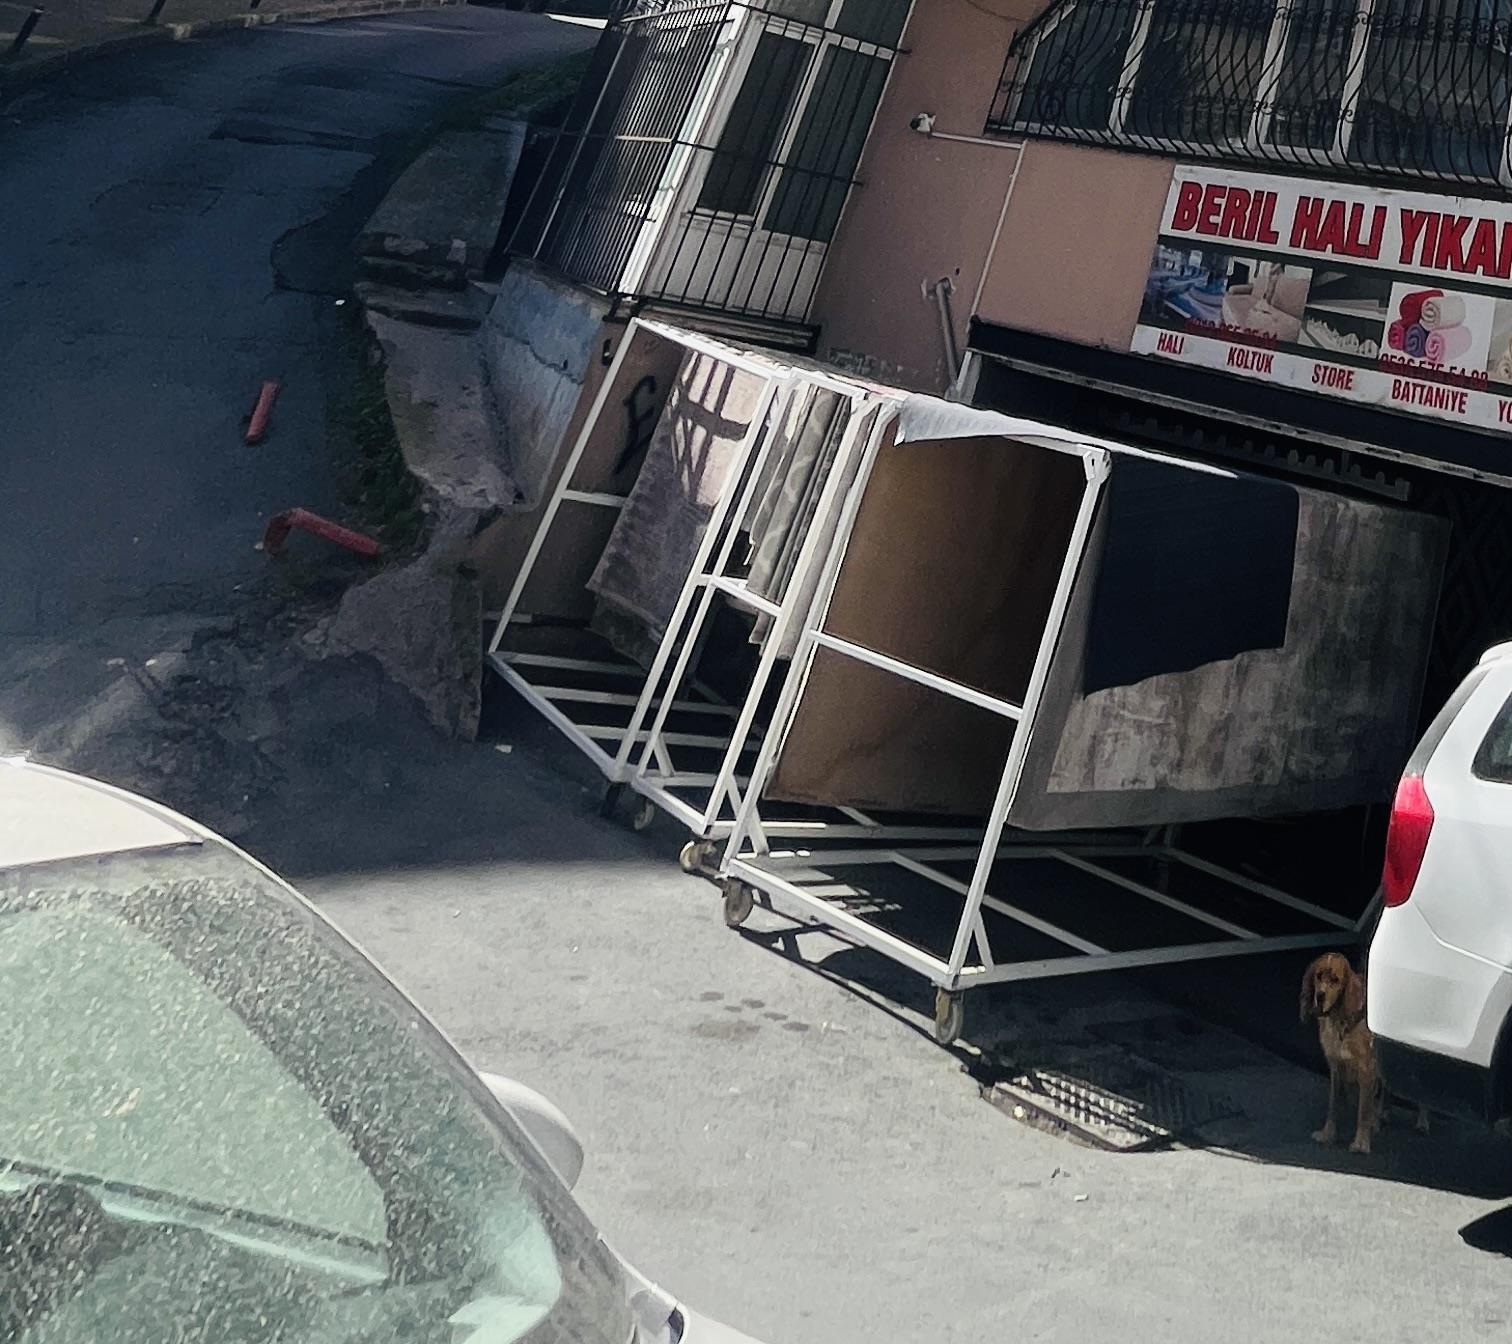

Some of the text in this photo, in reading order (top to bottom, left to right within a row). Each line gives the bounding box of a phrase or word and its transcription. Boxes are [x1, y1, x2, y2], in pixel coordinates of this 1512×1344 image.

[1289, 196, 1388, 261] HALI
[1156, 331, 1185, 356] HALI
[1226, 346, 1275, 375] KOLTUK
[1311, 363, 1356, 391] STORE
